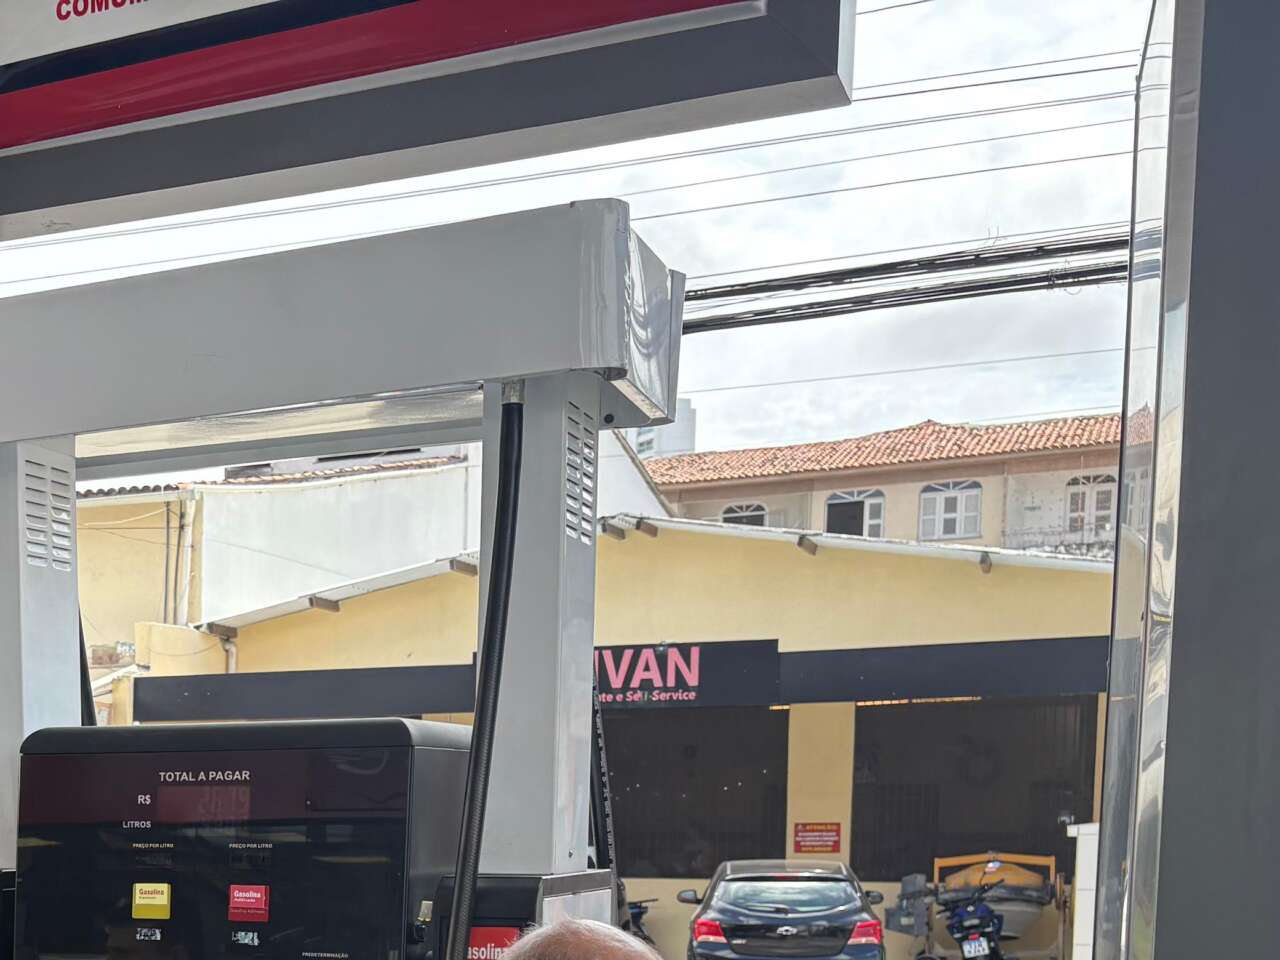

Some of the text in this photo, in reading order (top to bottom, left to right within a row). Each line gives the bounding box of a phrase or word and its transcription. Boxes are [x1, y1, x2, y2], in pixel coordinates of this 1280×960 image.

[56, 0, 148, 20] COM
[626, 689, 696, 702] Se-Service
[159, 770, 250, 782] TOTAL A PAGAR
[137, 794, 152, 805] R$
[122, 820, 152, 828] LITROS
[467, 943, 505, 960] asolin
